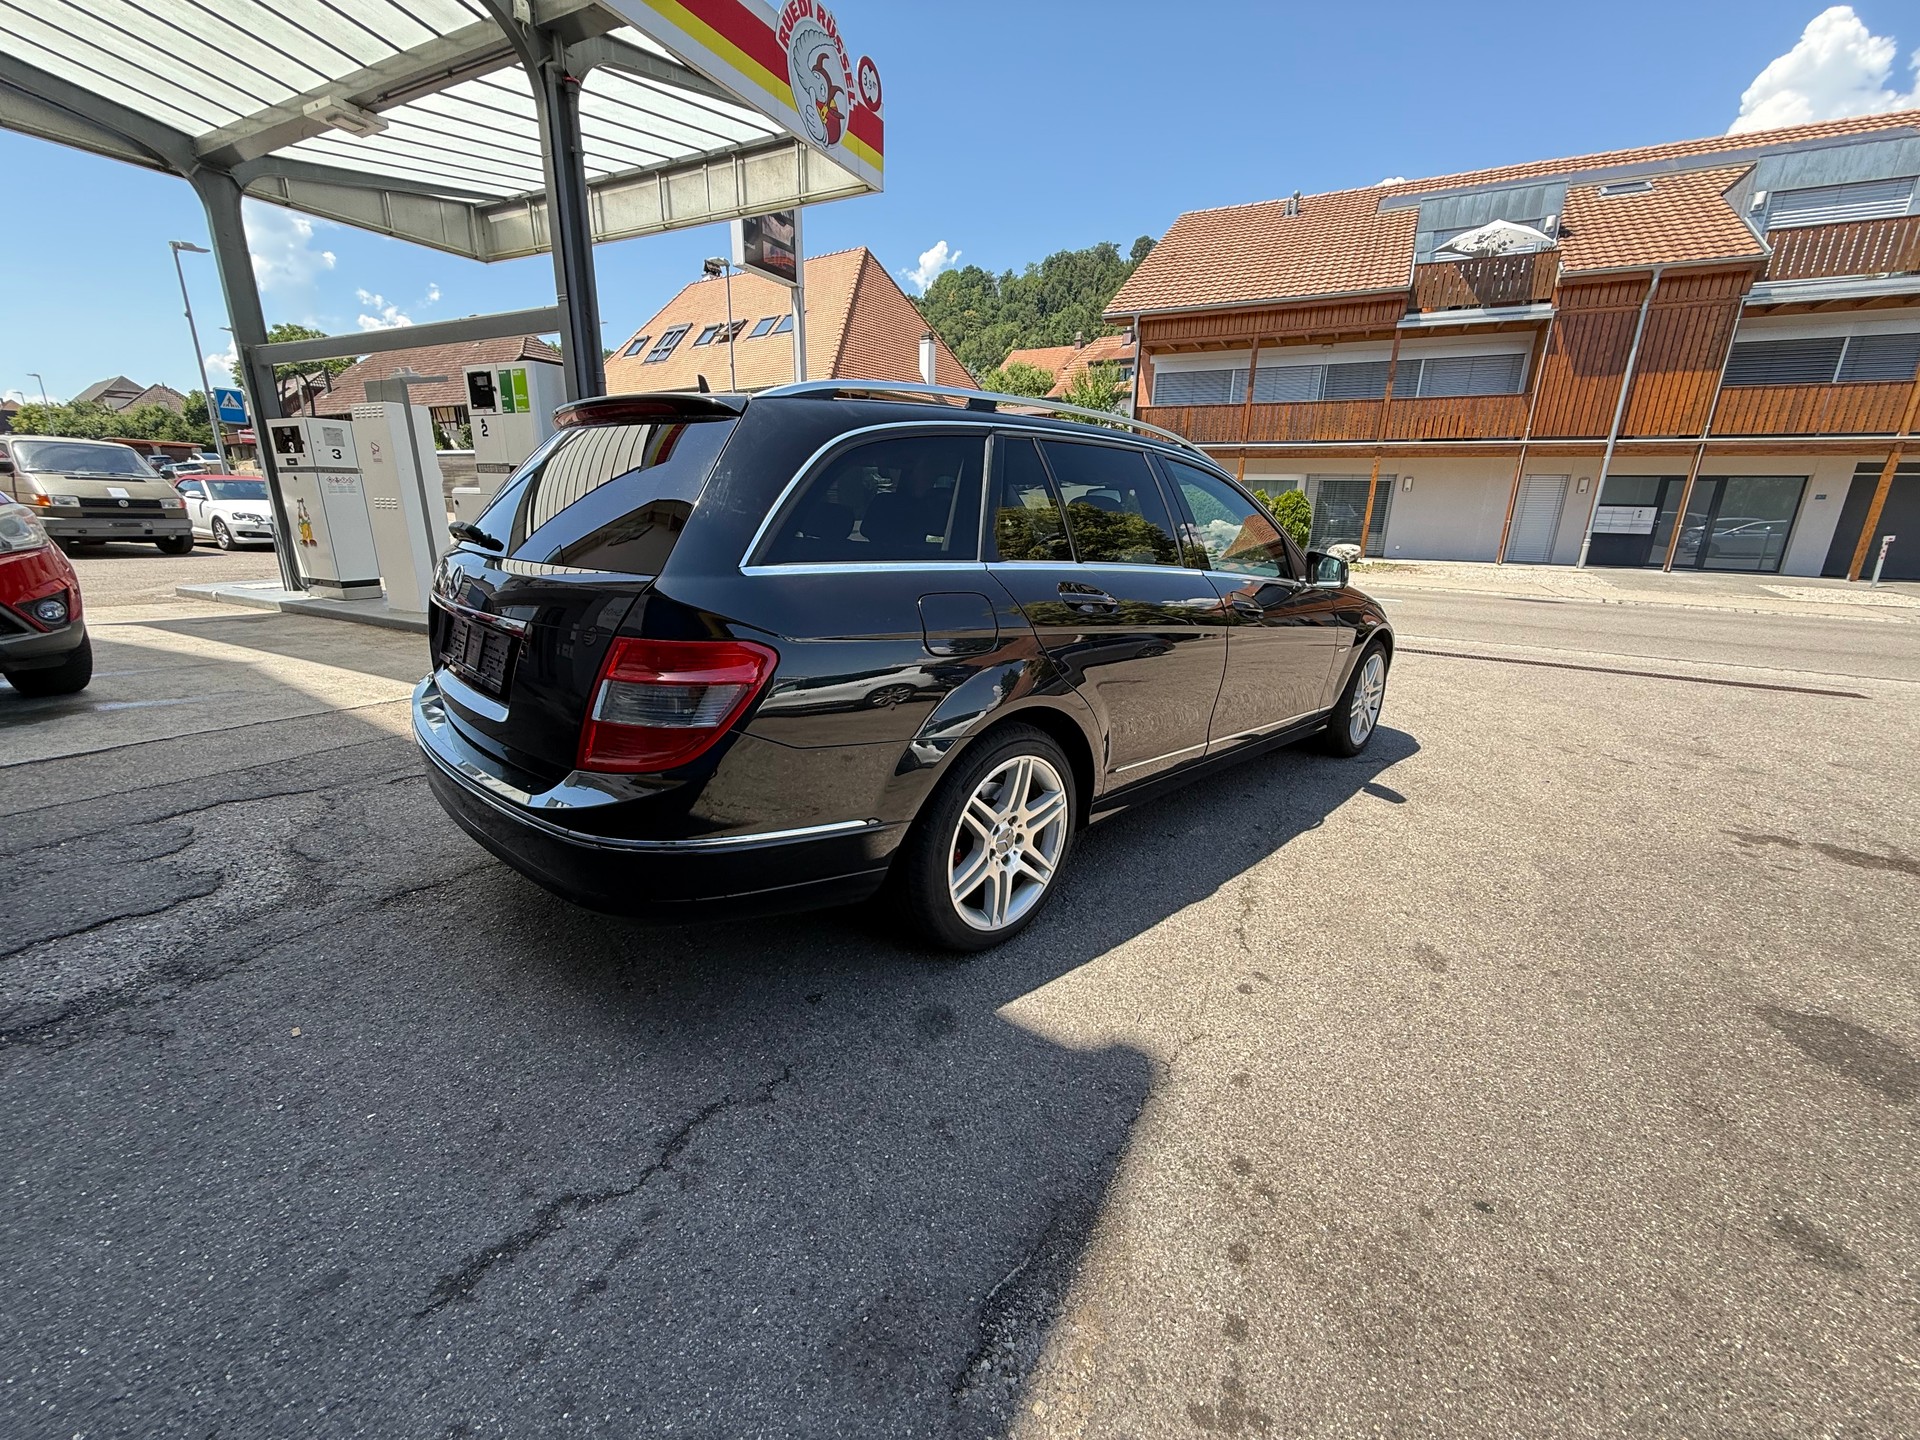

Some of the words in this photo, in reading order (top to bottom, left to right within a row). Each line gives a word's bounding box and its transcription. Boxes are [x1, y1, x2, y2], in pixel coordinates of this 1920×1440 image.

[779, 0, 813, 50] RUEDI
[817, 3, 856, 106] RÜSSEL
[481, 423, 489, 437] 2
[288, 441, 295, 453] 3
[331, 448, 342, 460] 3
